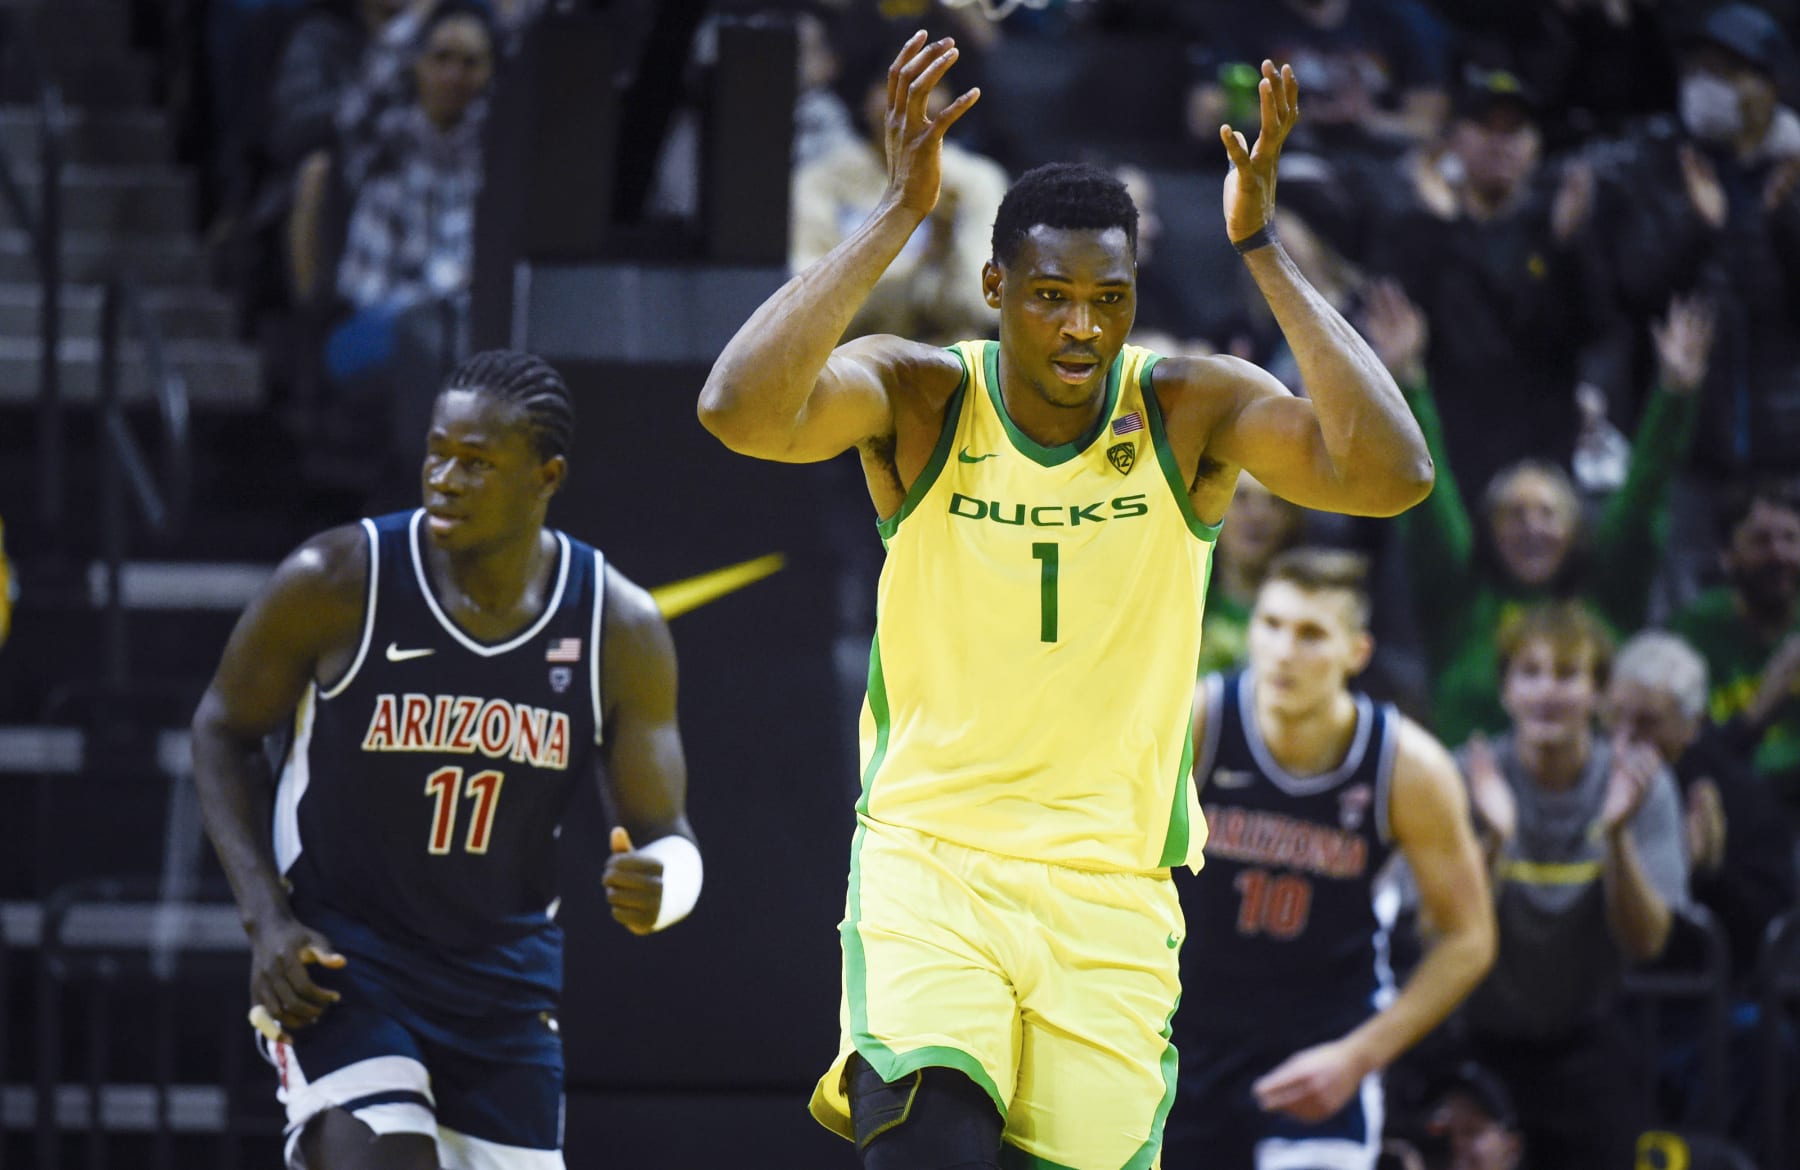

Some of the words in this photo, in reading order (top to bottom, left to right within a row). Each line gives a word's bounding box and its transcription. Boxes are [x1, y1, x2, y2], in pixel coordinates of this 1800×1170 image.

[948, 492, 1148, 526] DUCKS
[1032, 542, 1059, 642] 1
[361, 694, 570, 770] ARIZONA
[425, 766, 504, 854] 11
[1234, 868, 1313, 938] 10
